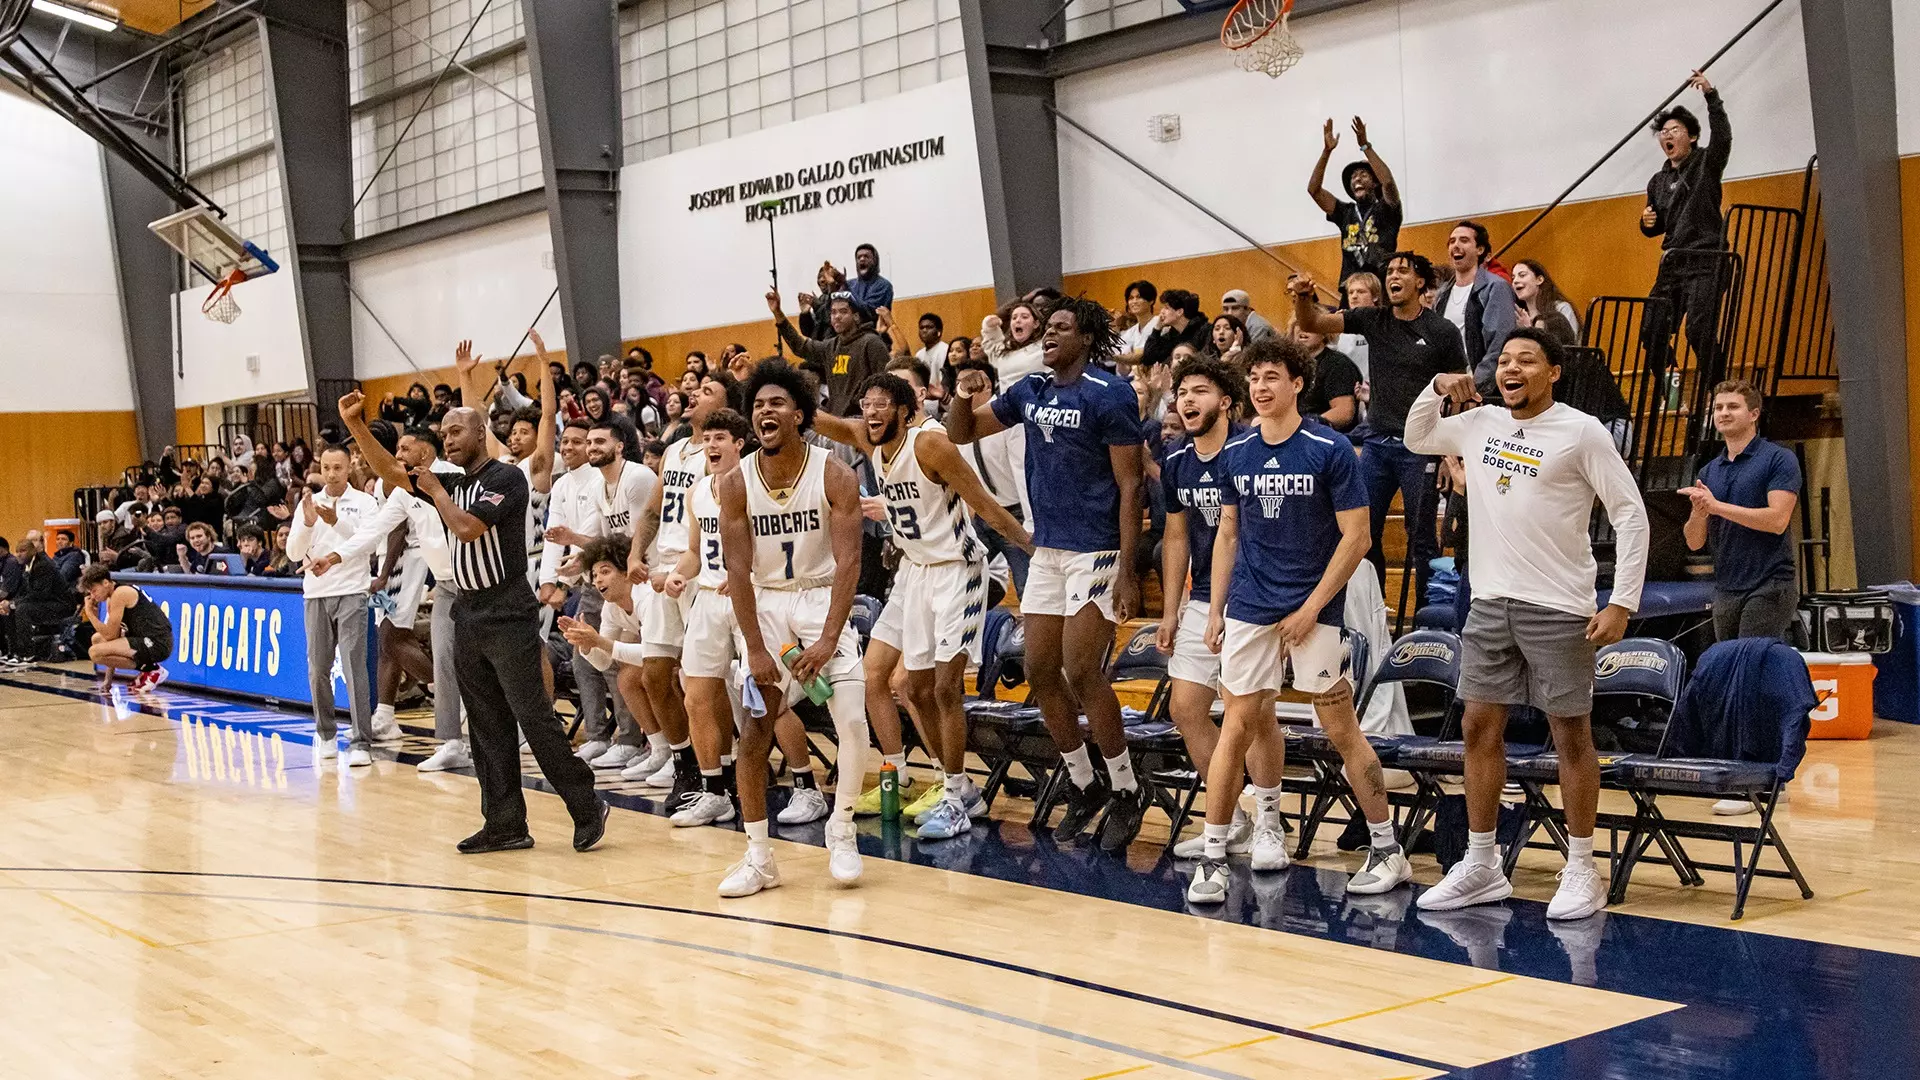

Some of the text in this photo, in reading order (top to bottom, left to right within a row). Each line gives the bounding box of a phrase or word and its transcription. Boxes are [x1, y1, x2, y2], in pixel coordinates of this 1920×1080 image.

[688, 136, 945, 211] JOSEPH EDWARD GALLO GYMNASIUM
[826, 178, 875, 205] COURT
[1034, 406, 1081, 428] MERCED
[1487, 436, 1501, 446] UC
[1502, 441, 1544, 458] MERCED
[1482, 454, 1539, 478] BOBCATS
[1177, 488, 1191, 506] UC
[1233, 474, 1314, 496] UC MERCED
[662, 491, 685, 524] 21
[781, 541, 795, 580] 1
[178, 602, 282, 677] BOBCATS
[1809, 679, 1839, 721] G
[882, 779, 892, 792] G
[1634, 767, 1701, 783] UC MERCED
